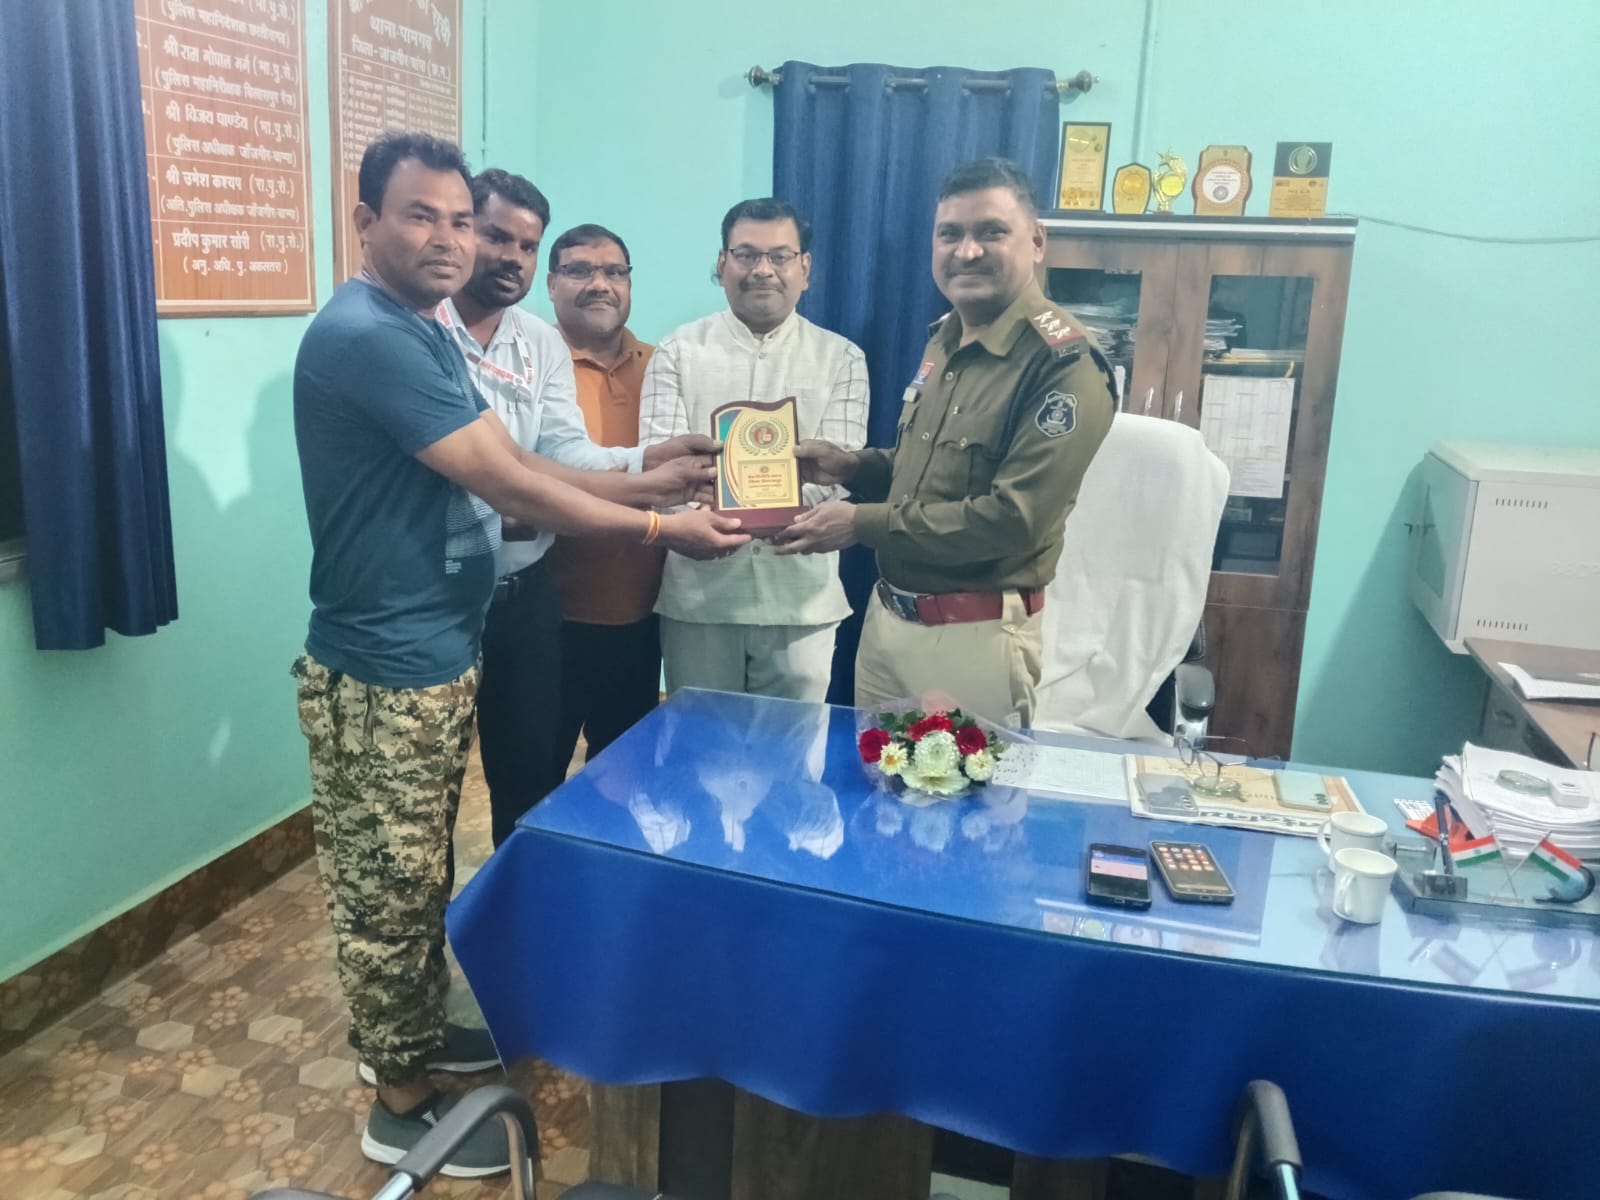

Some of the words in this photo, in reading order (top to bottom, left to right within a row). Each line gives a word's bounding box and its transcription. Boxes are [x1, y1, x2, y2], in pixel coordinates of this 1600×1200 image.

[163, 35, 179, 57] श्री
[181, 44, 199, 63] राम
[203, 44, 232, 70] गोपाल
[165, 100, 181, 122] श्री
[185, 102, 214, 125] विजय
[216, 111, 249, 131] पाण्डेय
[166, 164, 180, 185] श्री
[183, 168, 210, 189] उमेश
[212, 174, 242, 191] कश्यप
[172, 226, 199, 248] प्रदीप
[200, 233, 228, 254] कुमार
[230, 231, 250, 251] सोरी
